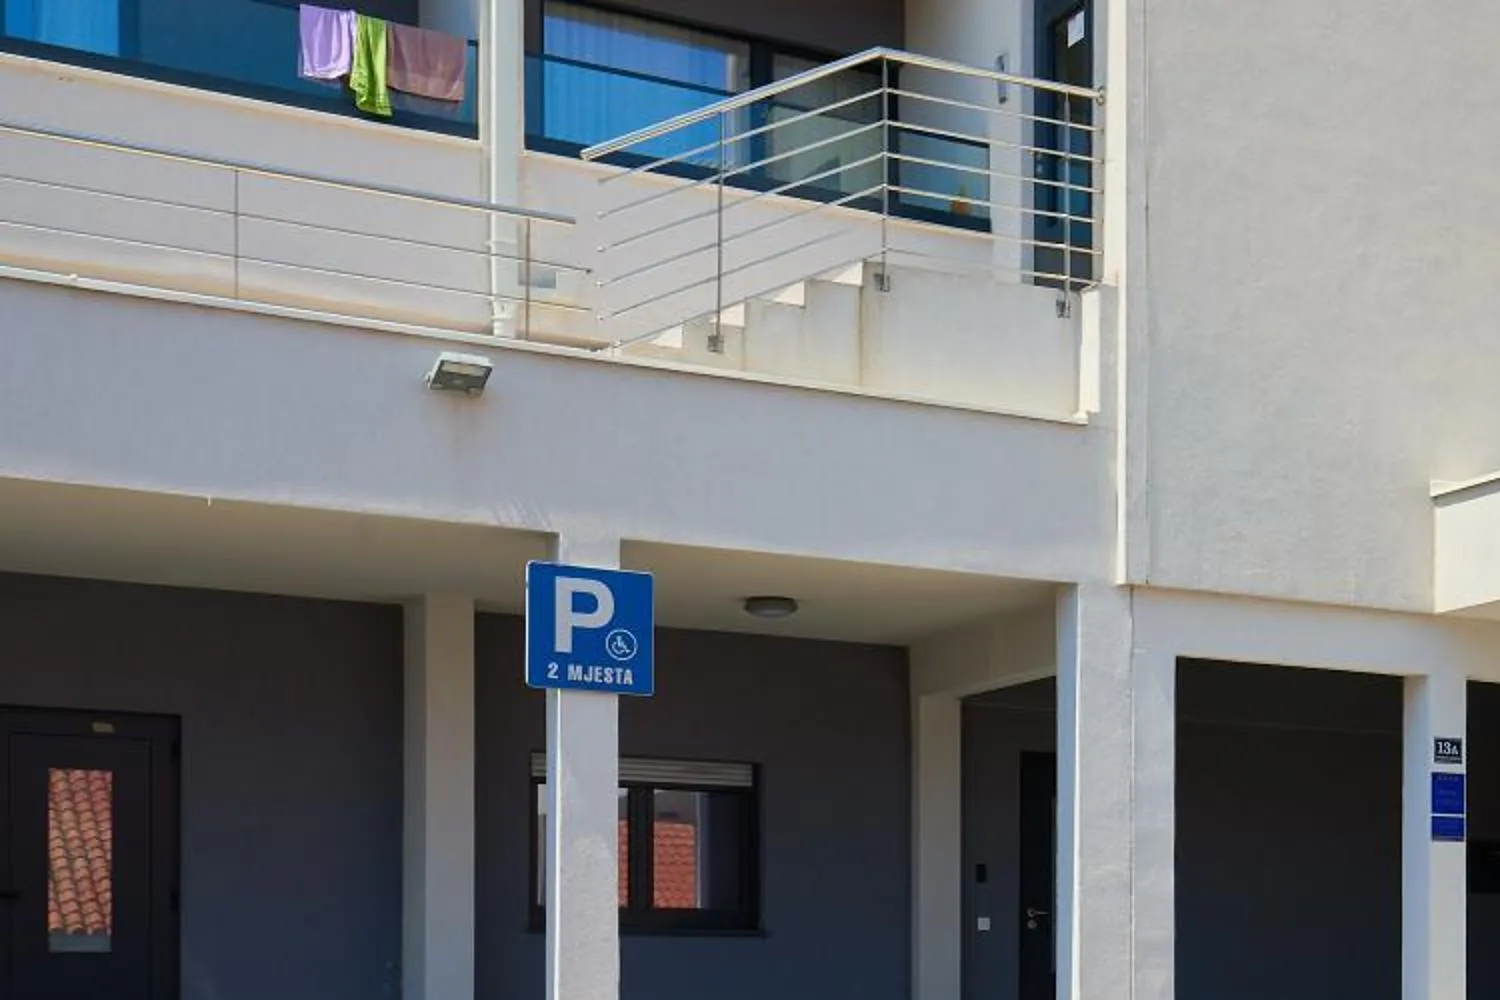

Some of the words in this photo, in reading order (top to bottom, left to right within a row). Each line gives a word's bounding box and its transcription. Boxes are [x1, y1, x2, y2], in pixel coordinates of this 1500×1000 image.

[555, 576, 615, 653] P
[547, 661, 559, 679] 2
[567, 663, 633, 685] MJESTA
